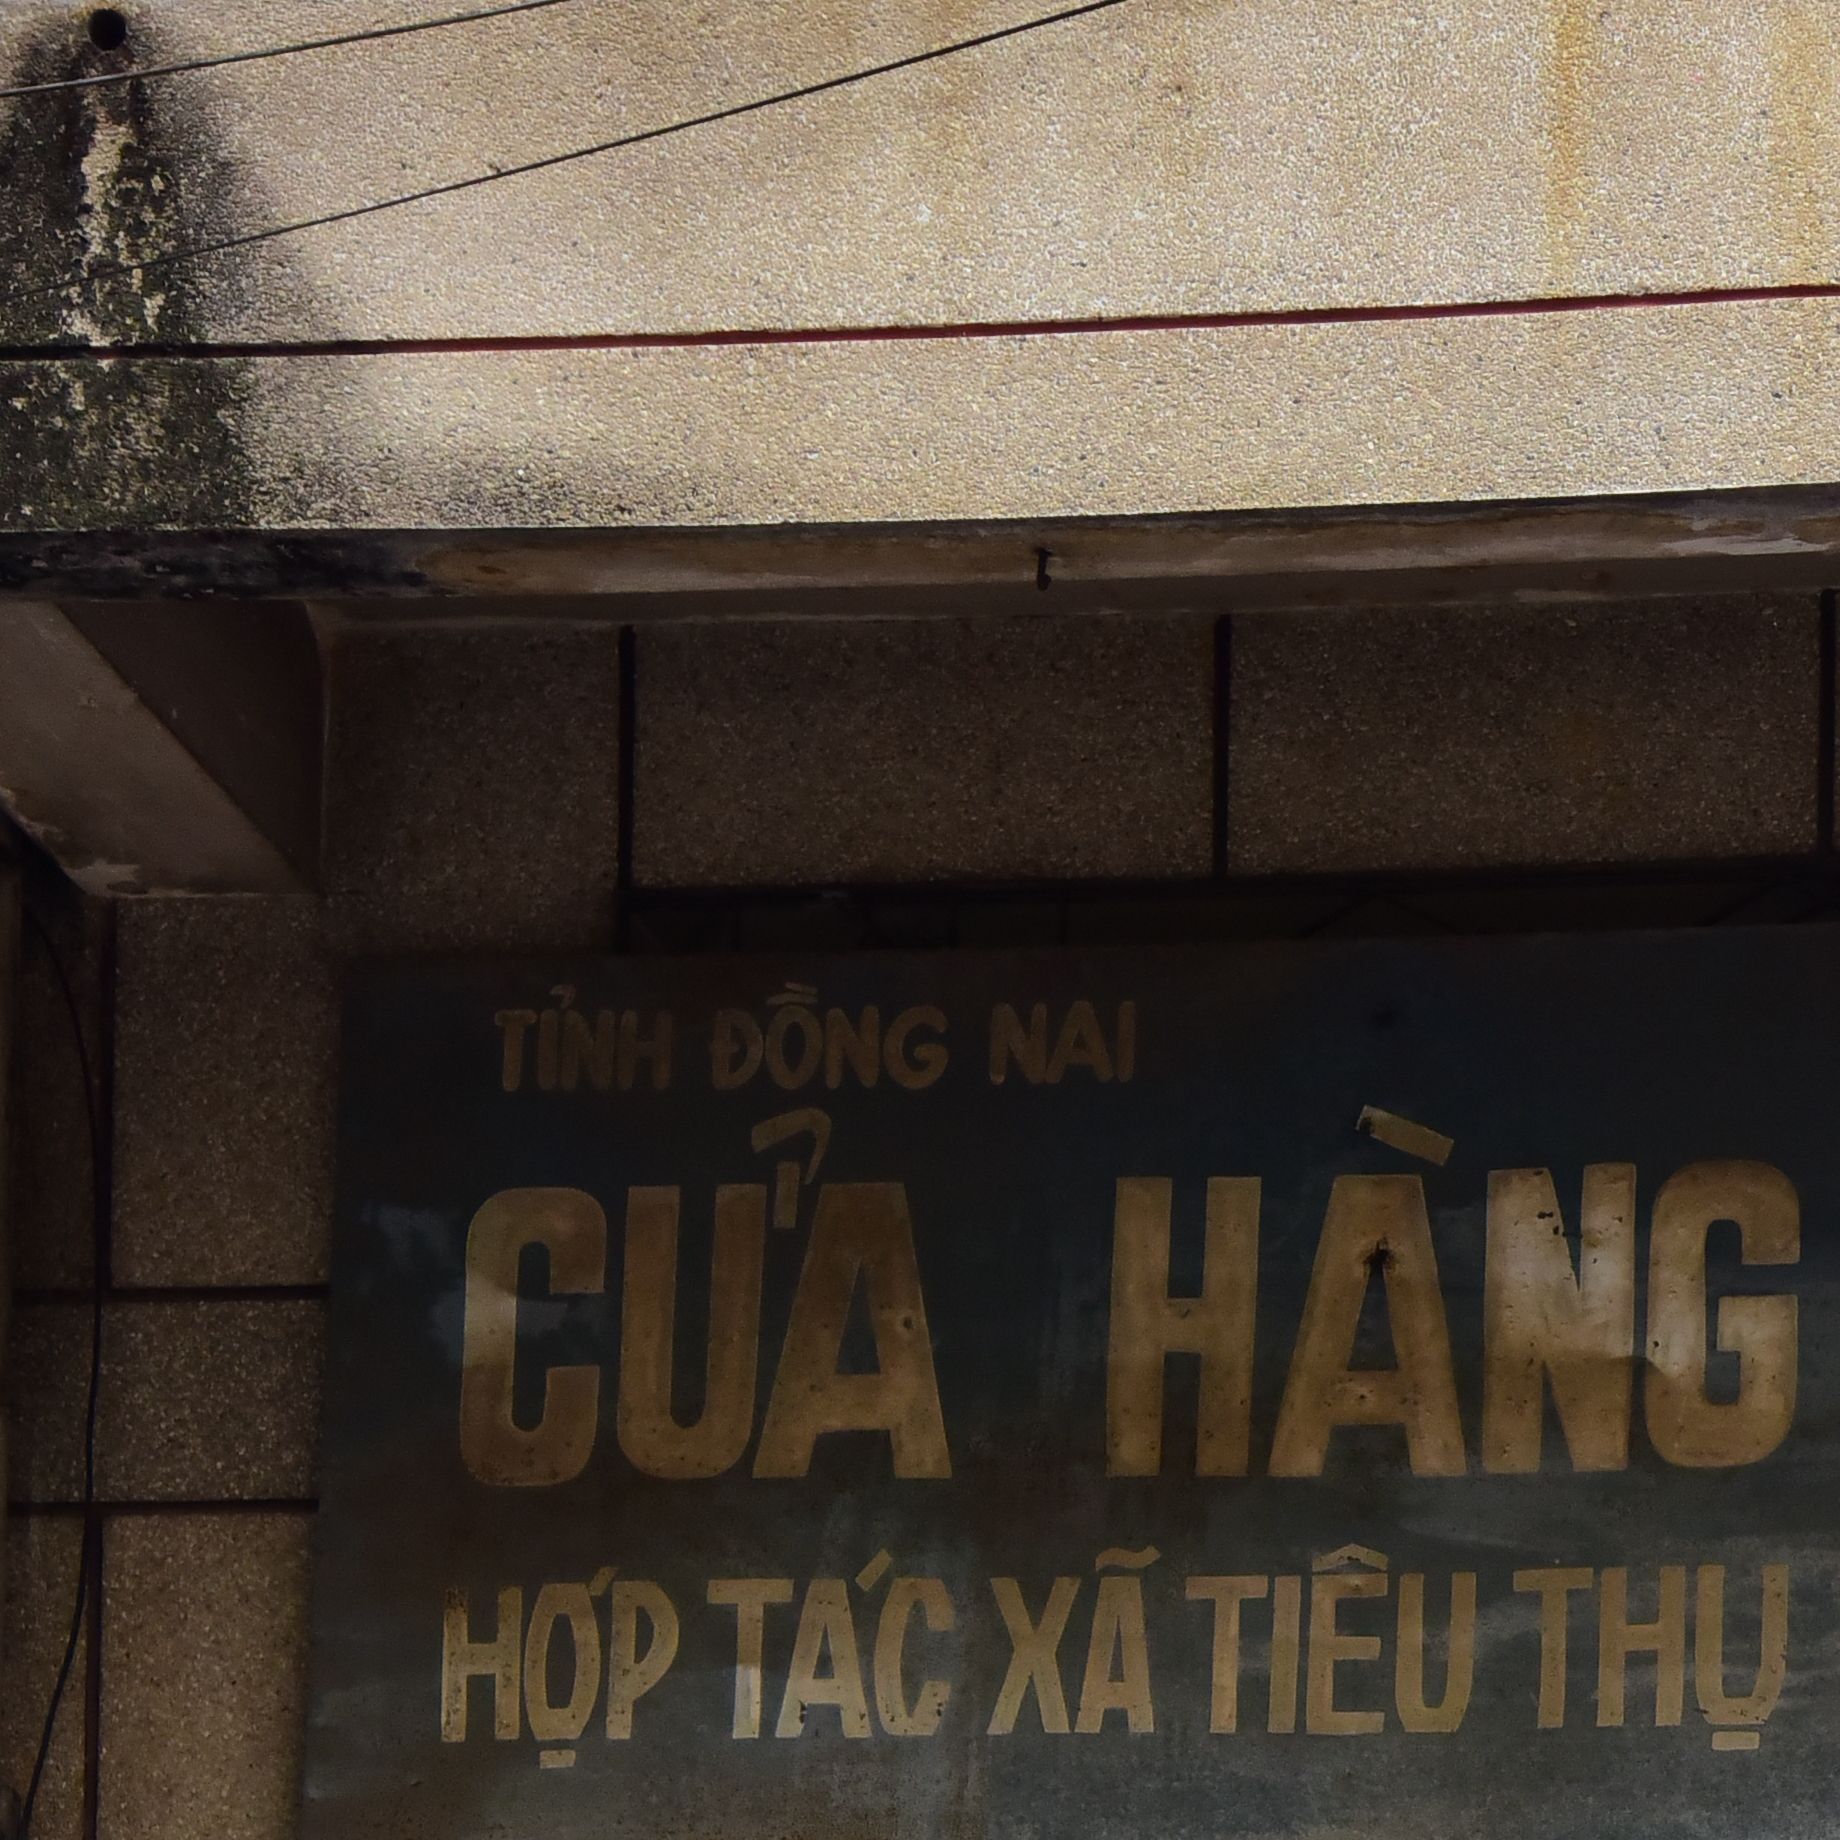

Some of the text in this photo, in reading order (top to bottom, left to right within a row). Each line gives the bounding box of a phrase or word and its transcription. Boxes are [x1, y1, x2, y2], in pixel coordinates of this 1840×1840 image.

[493, 981, 1137, 1092] TỈNH ĐỒNG NAI
[457, 1105, 953, 1488] CỬA
[1107, 1104, 1801, 1479] HÀNG
[440, 1564, 682, 1770] HỢP
[706, 1548, 956, 1741] TÁC
[987, 1545, 1162, 1736] XÃ
[1184, 1542, 1478, 1735] TIÊU
[1513, 1563, 1790, 1751] THỤ
